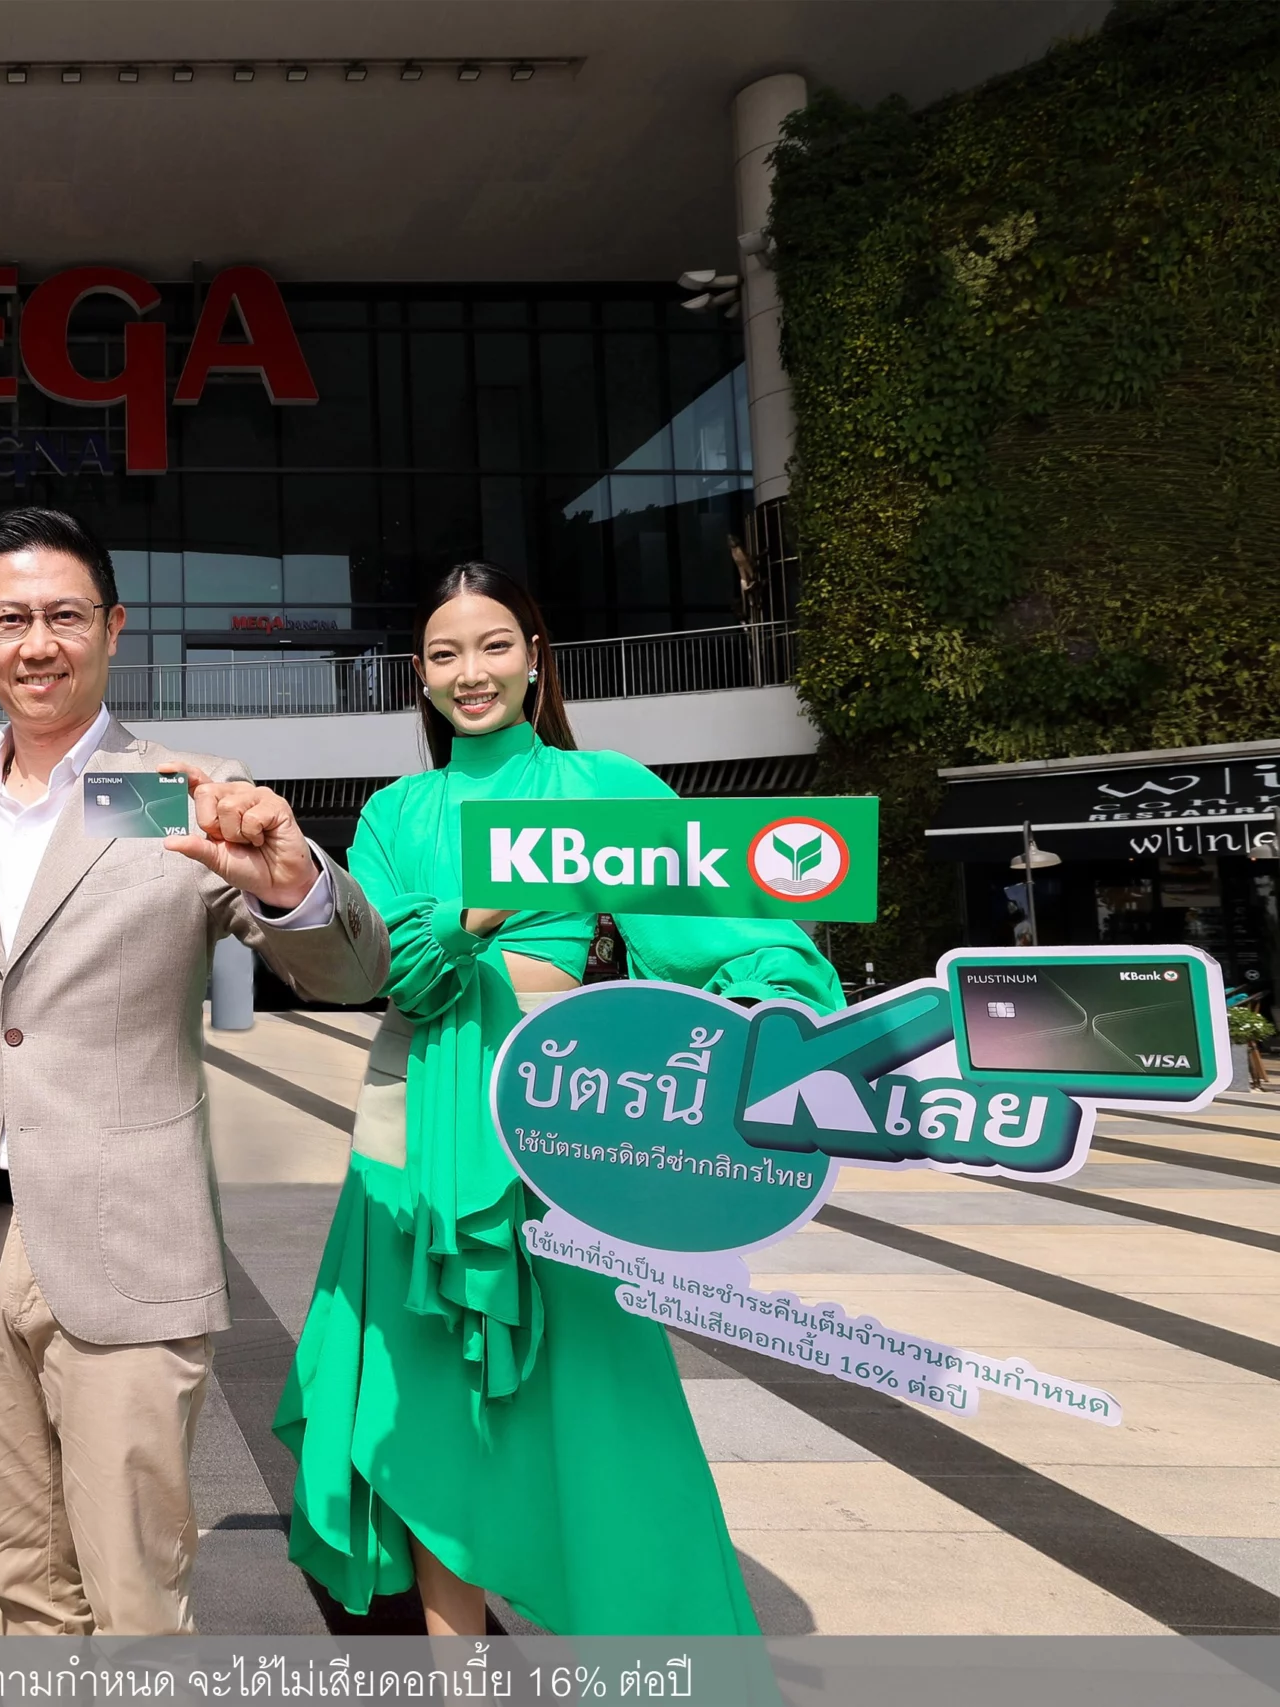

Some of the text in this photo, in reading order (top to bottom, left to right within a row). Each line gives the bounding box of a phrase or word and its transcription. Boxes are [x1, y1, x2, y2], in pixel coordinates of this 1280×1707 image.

[231, 615, 285, 636] MEGA
[163, 826, 187, 836] VISA
[489, 820, 730, 889] KBank
[967, 973, 1037, 984] PLUSTINUM
[1119, 970, 1162, 981] KBank
[518, 1026, 725, 1126] บัตรนี้
[1134, 1053, 1191, 1069] VISA
[515, 1128, 814, 1190] ใช้บัตรเครดิตวีซ่ากสิกรไทย
[528, 1225, 1111, 1418] ใช้เท่าที่จำเป็น และชำระคืนเต็มจำนวนตามกำหนด
[622, 1290, 968, 1411] จะได้ไม่เสียดอกเบี้ย 16% ต่อปี
